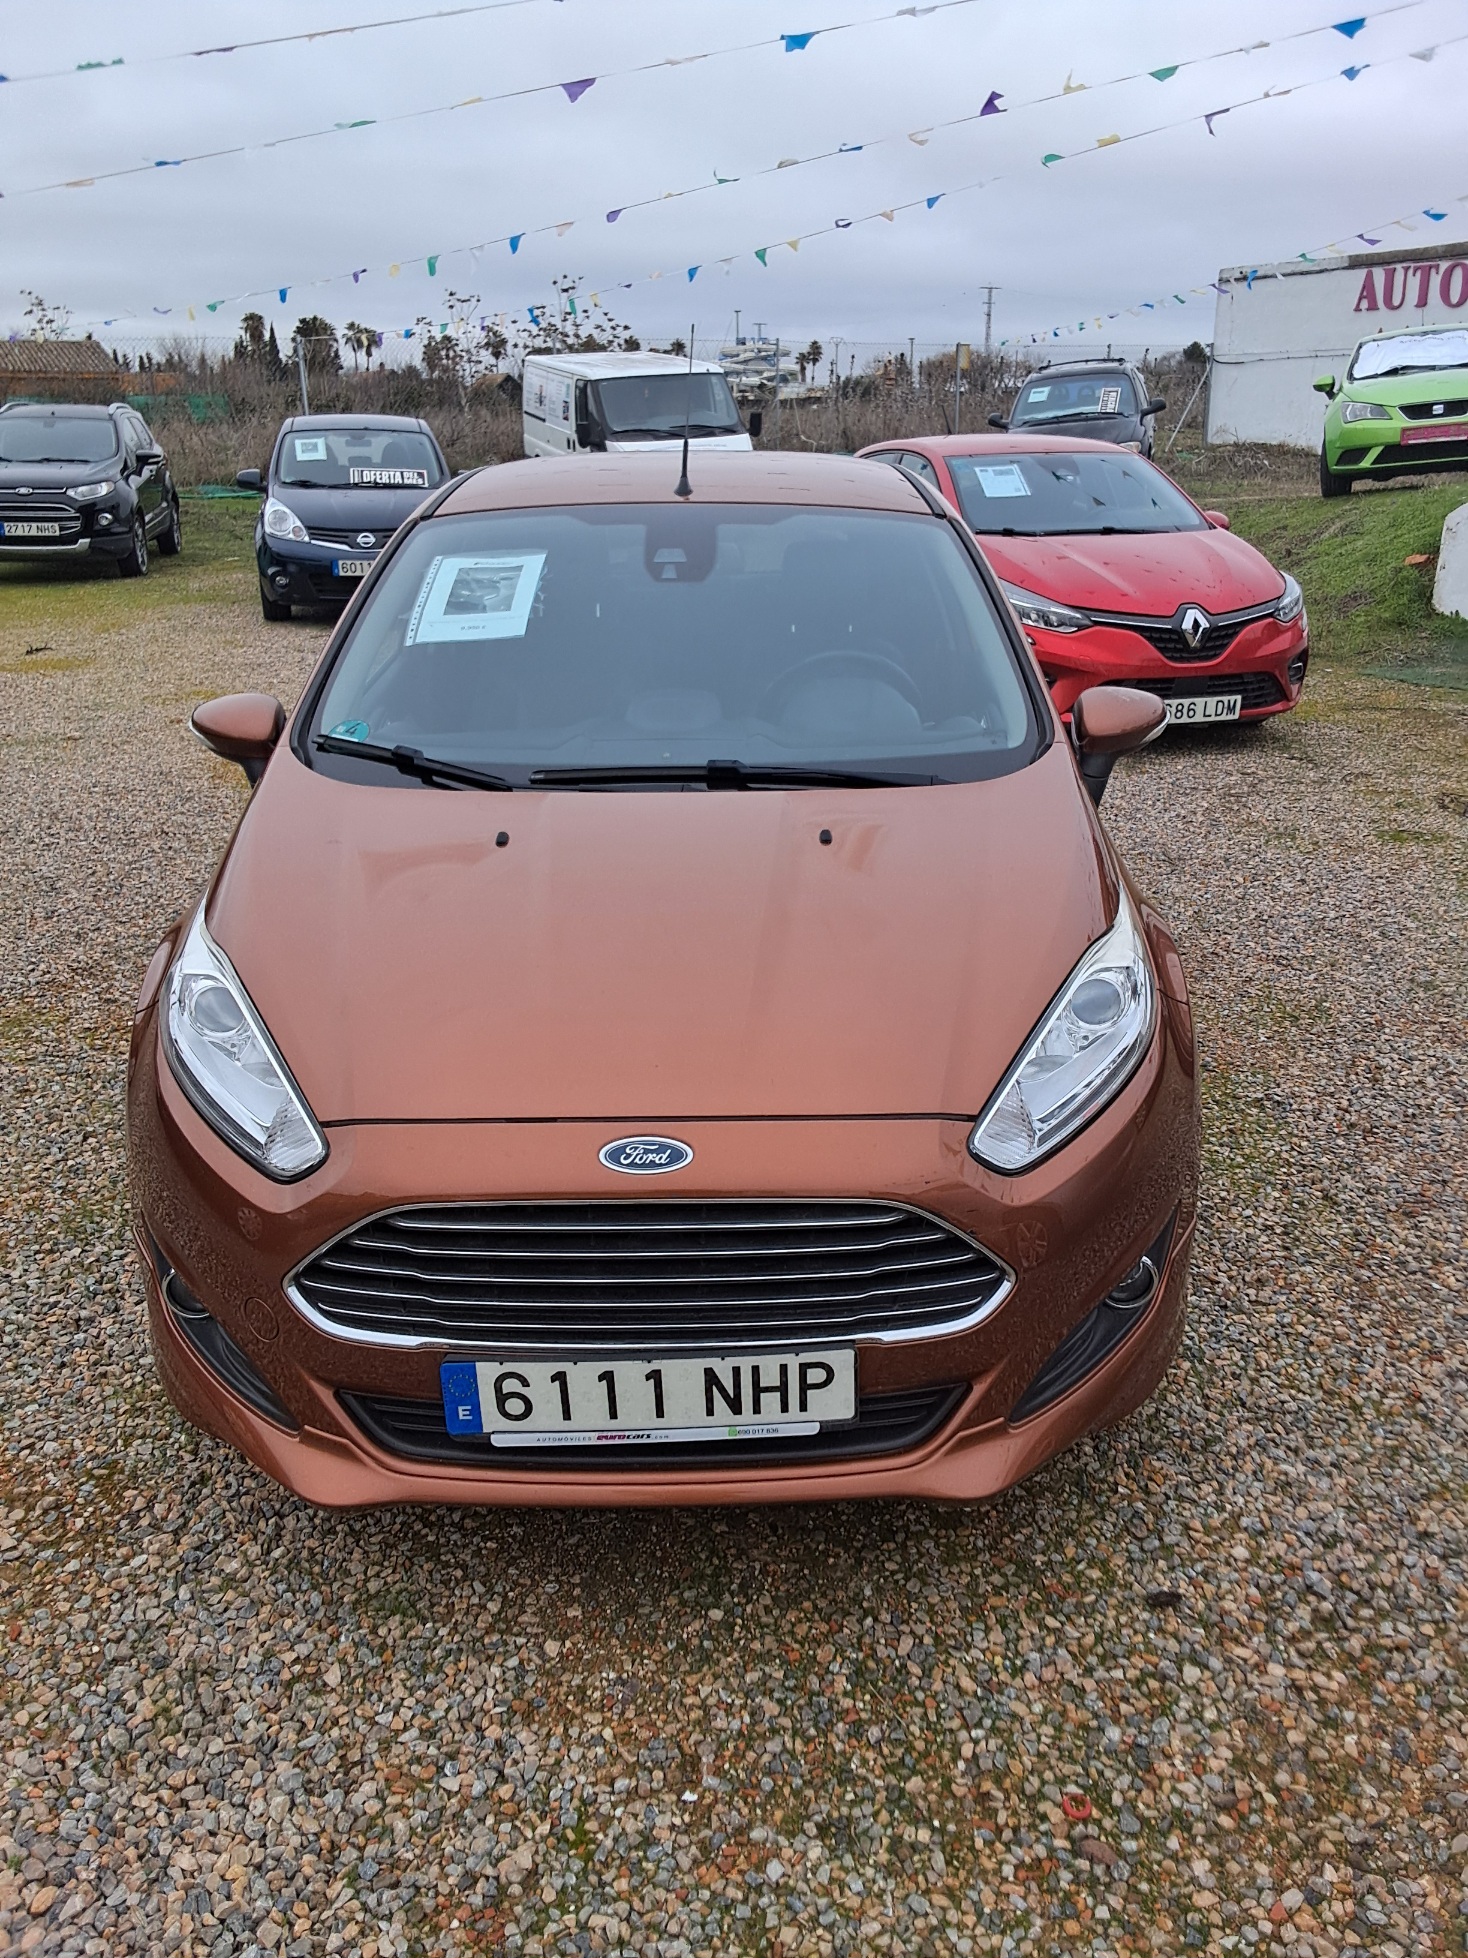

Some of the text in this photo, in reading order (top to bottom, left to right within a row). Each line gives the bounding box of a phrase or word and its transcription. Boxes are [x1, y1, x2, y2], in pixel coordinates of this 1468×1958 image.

[1353, 262, 1468, 311] AUTO
[362, 470, 402, 484] OFERTA
[6, 524, 57, 534] 2717 NHS
[1203, 699, 1238, 717] LDM
[345, 722, 361, 735] 4
[620, 1144, 671, 1165] Ford
[458, 1361, 836, 1422] E 6111 NHP
